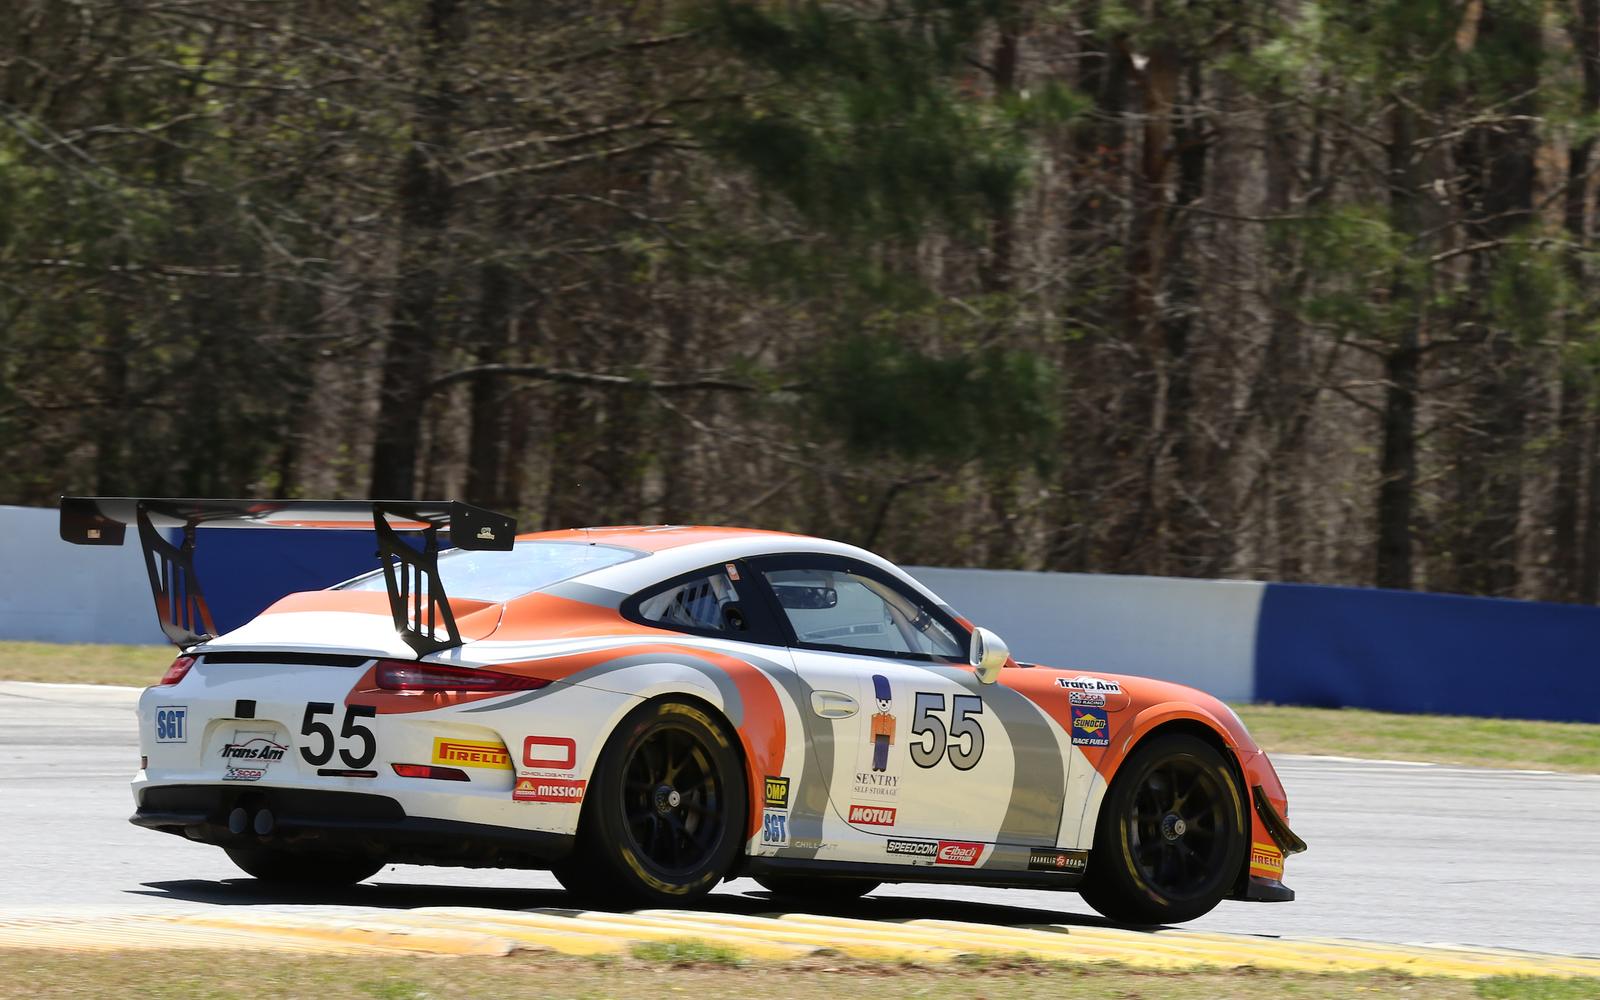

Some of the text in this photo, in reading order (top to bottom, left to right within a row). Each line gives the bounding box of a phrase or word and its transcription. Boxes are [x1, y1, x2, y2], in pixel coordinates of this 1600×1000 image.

[1058, 678, 1119, 691] Trans Am
[157, 710, 185, 739] SGT
[909, 691, 985, 771] 55
[1074, 718, 1106, 729] SUNOCO
[300, 701, 376, 769] 55
[1072, 737, 1109, 746] RACE FUELS
[222, 744, 285, 760] Trans Am
[439, 742, 508, 764] PIRELLI
[855, 773, 900, 787] SENTRY
[766, 783, 787, 800] OMP
[850, 807, 893, 823] MOTUL
[763, 813, 786, 843] SGT
[887, 841, 938, 855] SPEEDCOM
[1251, 848, 1282, 868] PIRELLI
